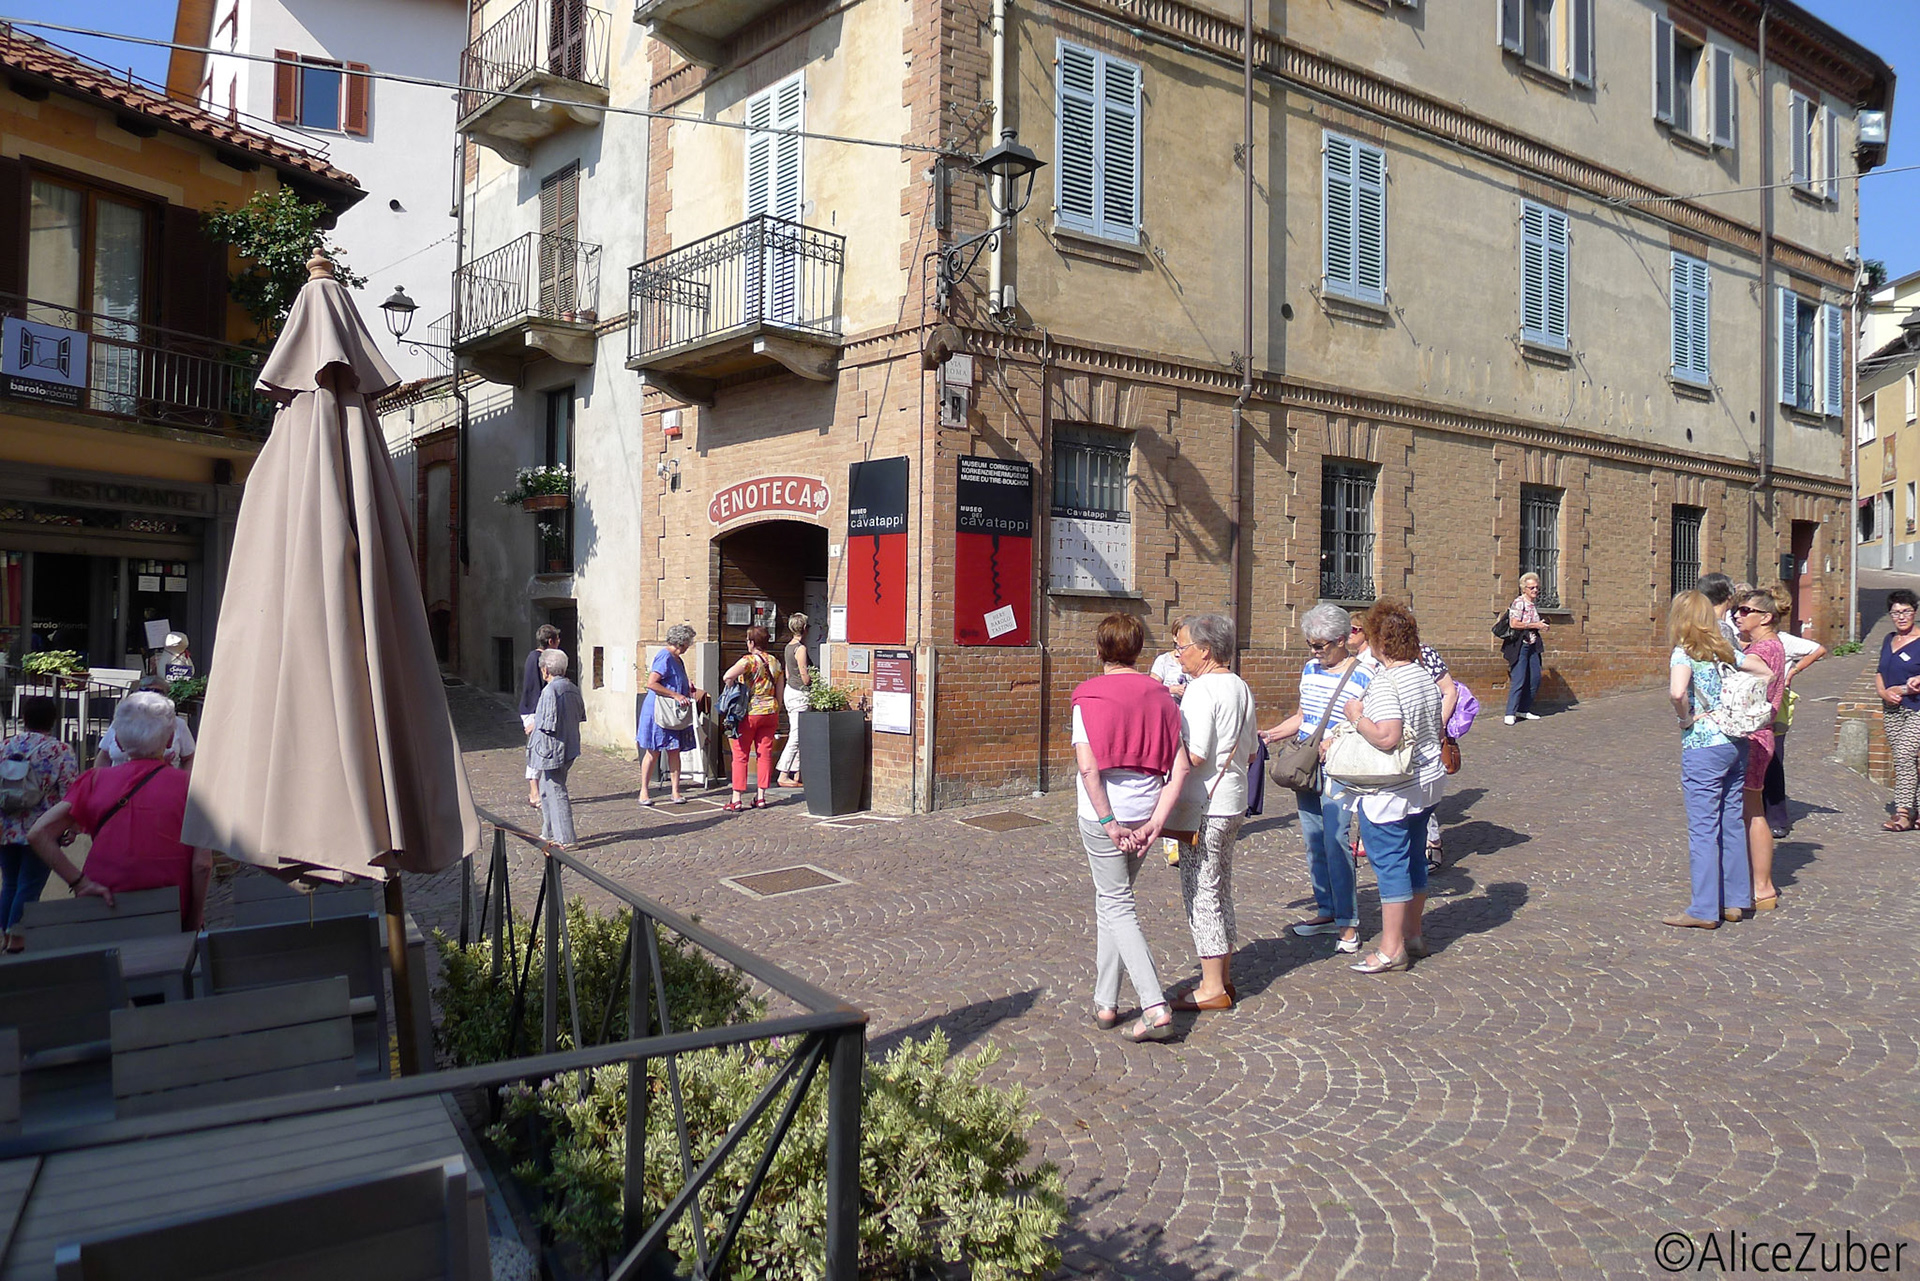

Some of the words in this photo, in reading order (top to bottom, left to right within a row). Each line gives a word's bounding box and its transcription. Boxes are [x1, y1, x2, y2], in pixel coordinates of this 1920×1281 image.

[10, 382, 77, 400] barolorooms
[961, 460, 987, 468] MUSEUM
[989, 463, 1029, 473] CORKSCREWS
[961, 467, 1029, 479] KORKENZIEHERMUSEUM
[720, 481, 812, 518] ENOTECA
[1067, 507, 1108, 519] Cavatappi
[850, 513, 904, 528] cavatappi
[960, 516, 1029, 532] cavatappi
[990, 616, 1011, 628] BAROLO
[991, 622, 1013, 634] TASTING
